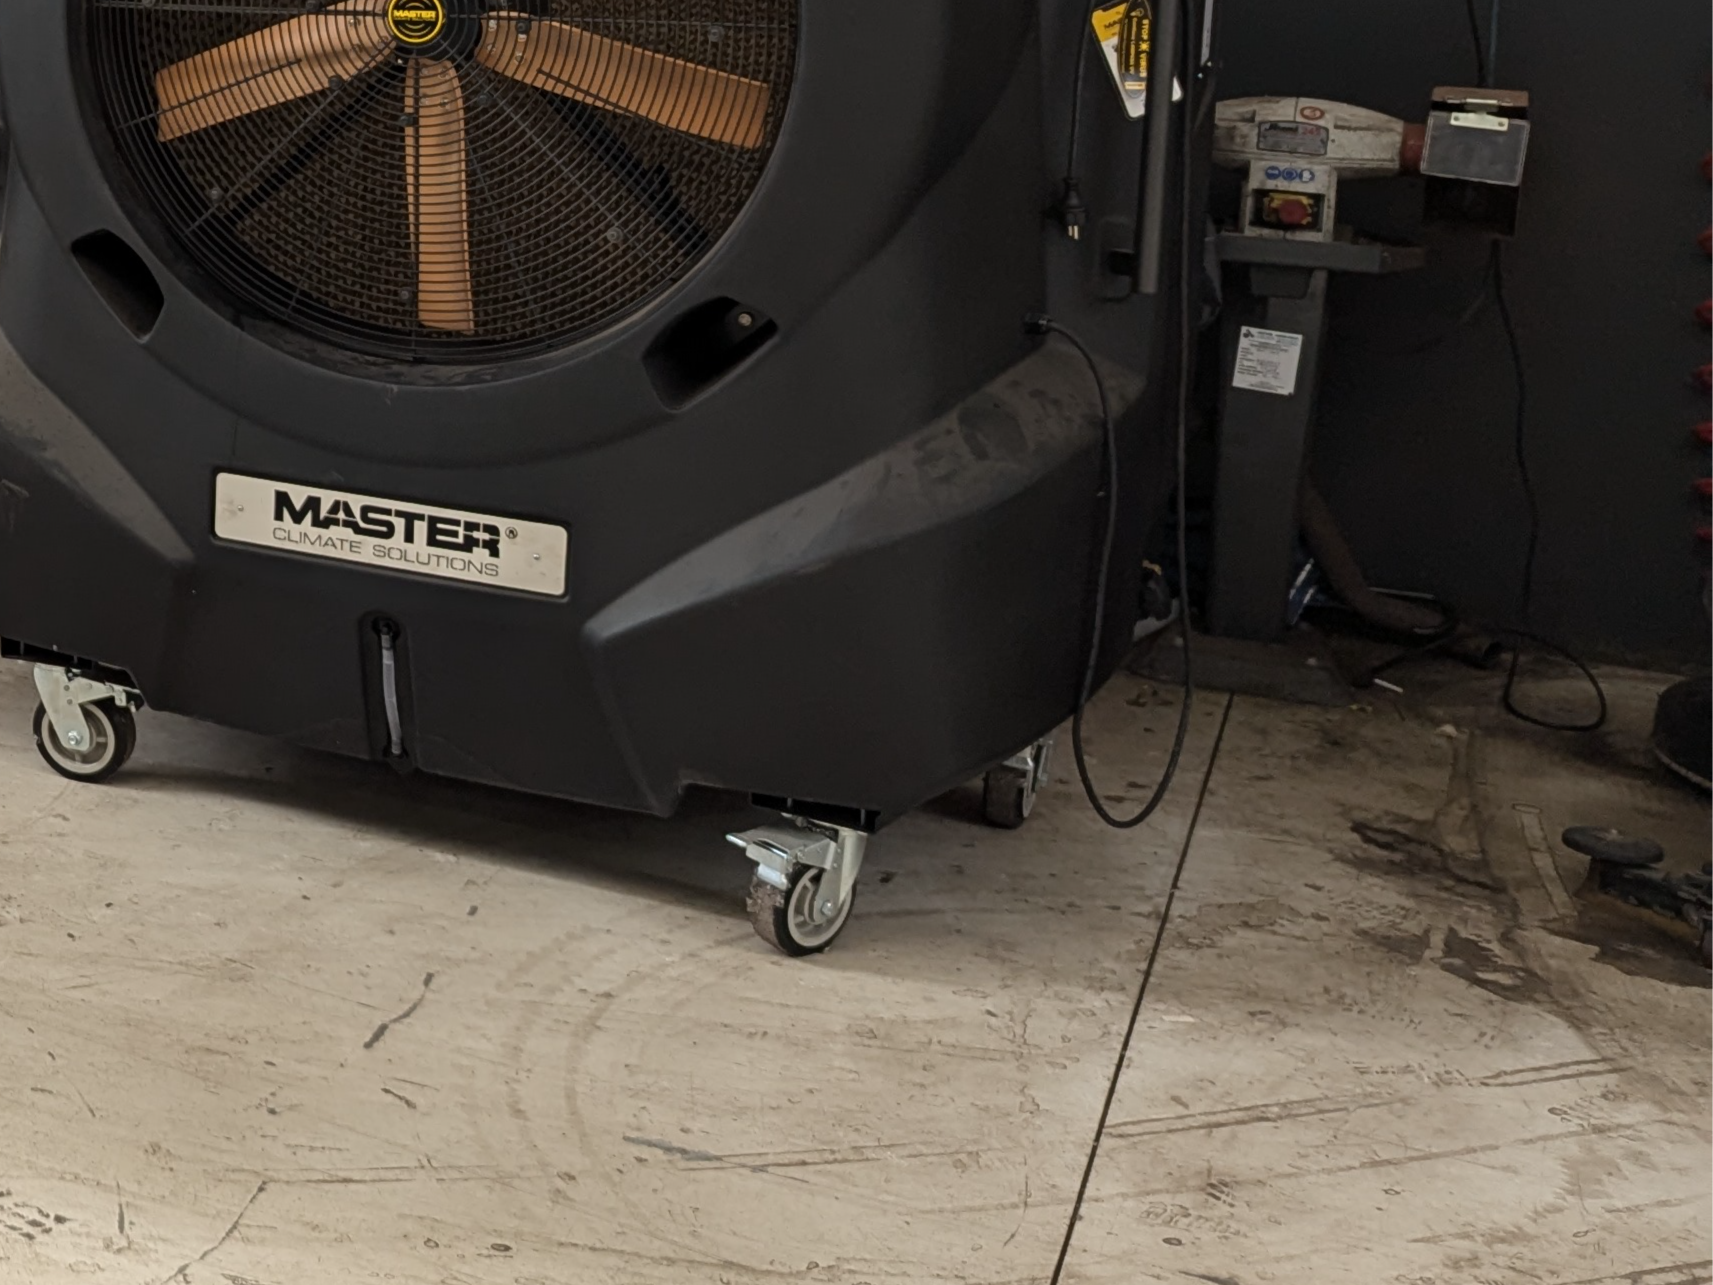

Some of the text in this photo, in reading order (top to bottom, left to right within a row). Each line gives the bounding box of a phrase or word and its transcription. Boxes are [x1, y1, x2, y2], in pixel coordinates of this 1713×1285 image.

[393, 9, 437, 19] MASTER
[273, 489, 501, 559] MASTER
[272, 526, 500, 577] CLIMATE SOLUTIONS
